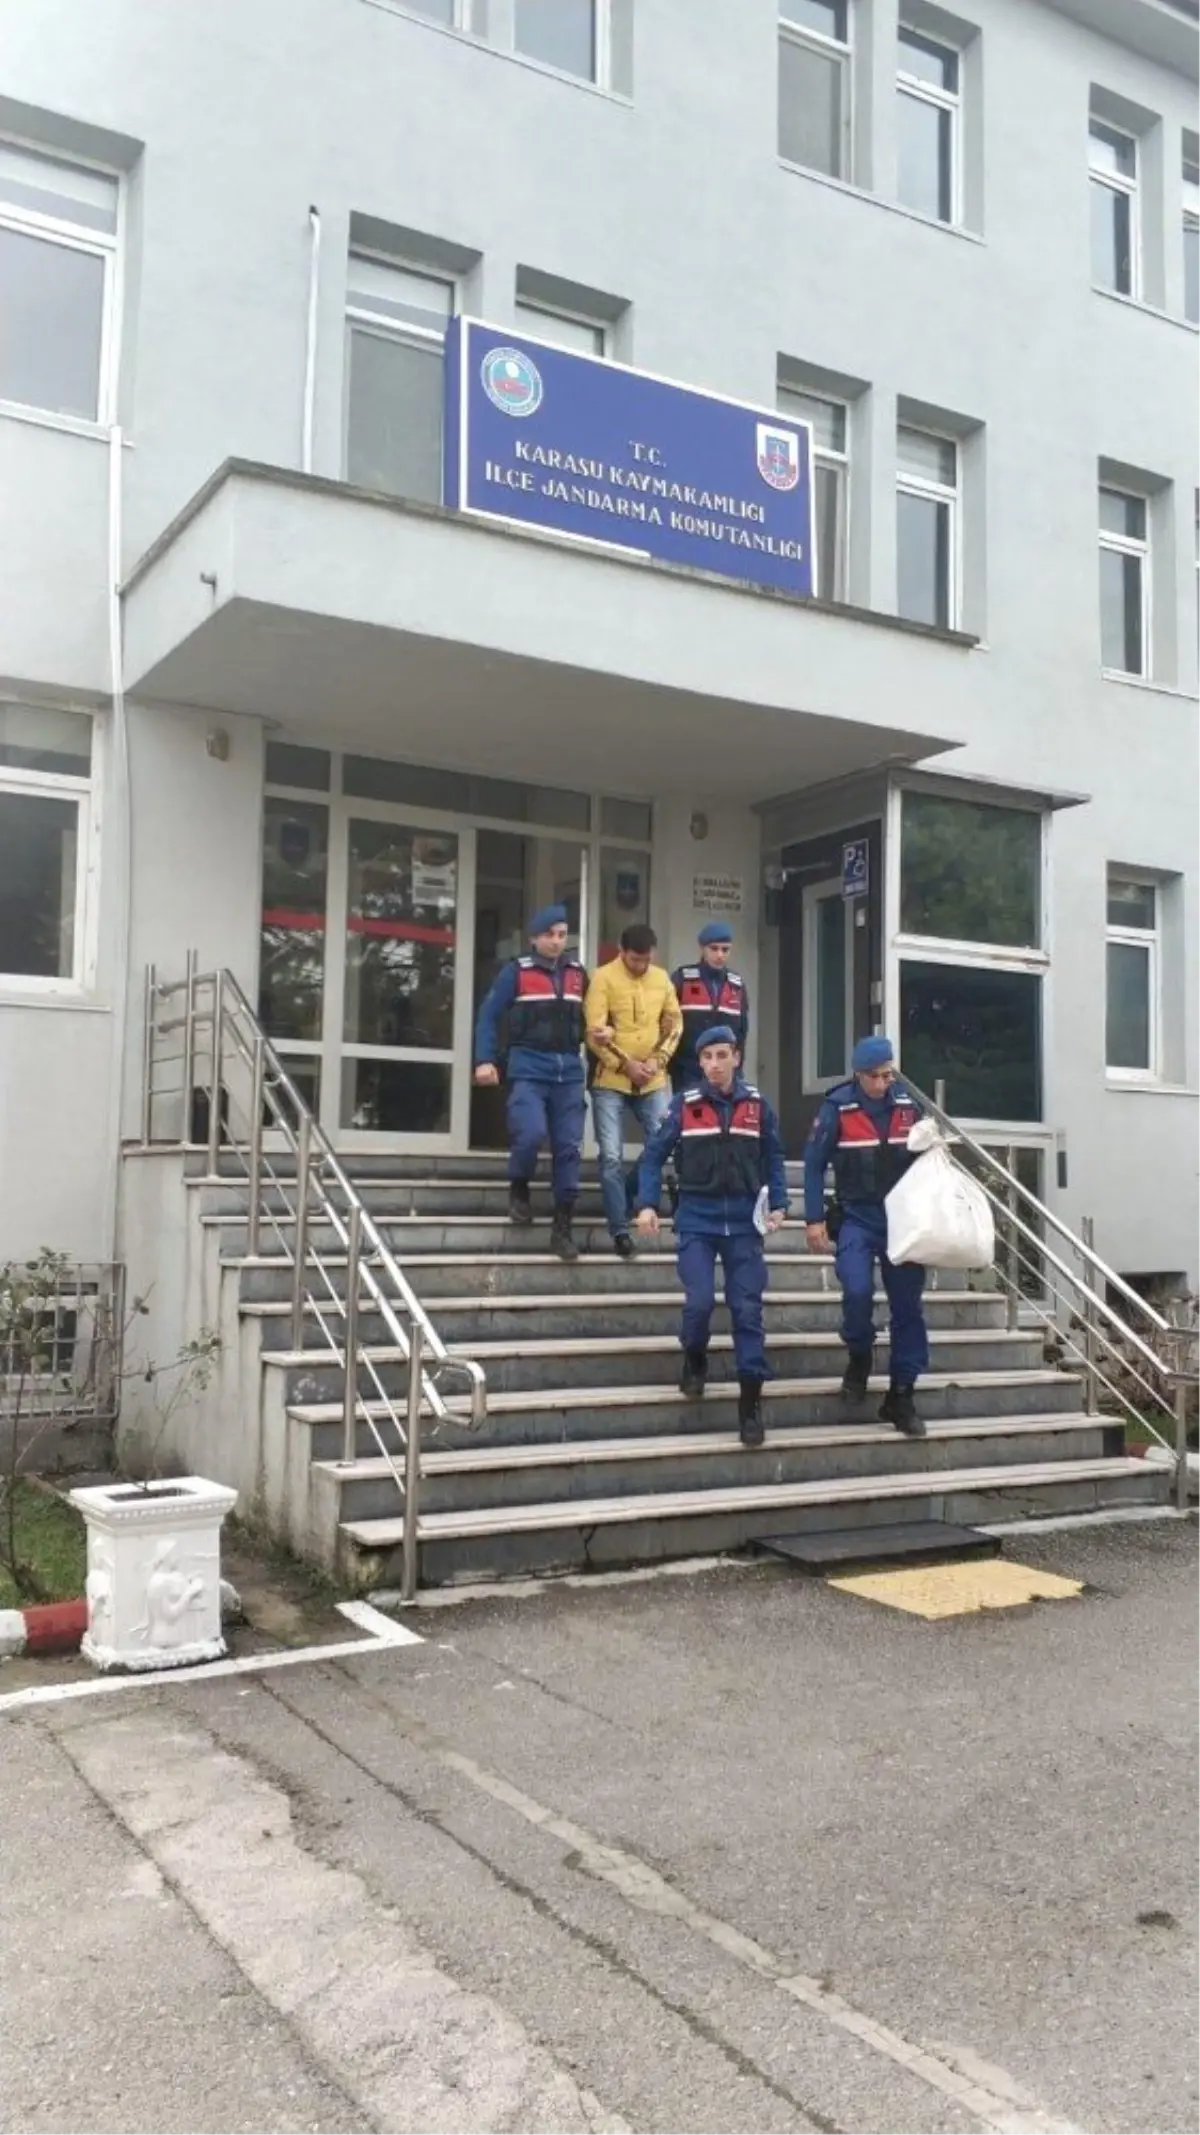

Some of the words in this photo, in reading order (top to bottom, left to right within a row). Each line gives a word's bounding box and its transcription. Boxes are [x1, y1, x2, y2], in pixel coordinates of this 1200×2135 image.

[515, 440, 603, 479] KARASU
[629, 440, 667, 468] T.C.
[541, 479, 663, 526] JANDARMA
